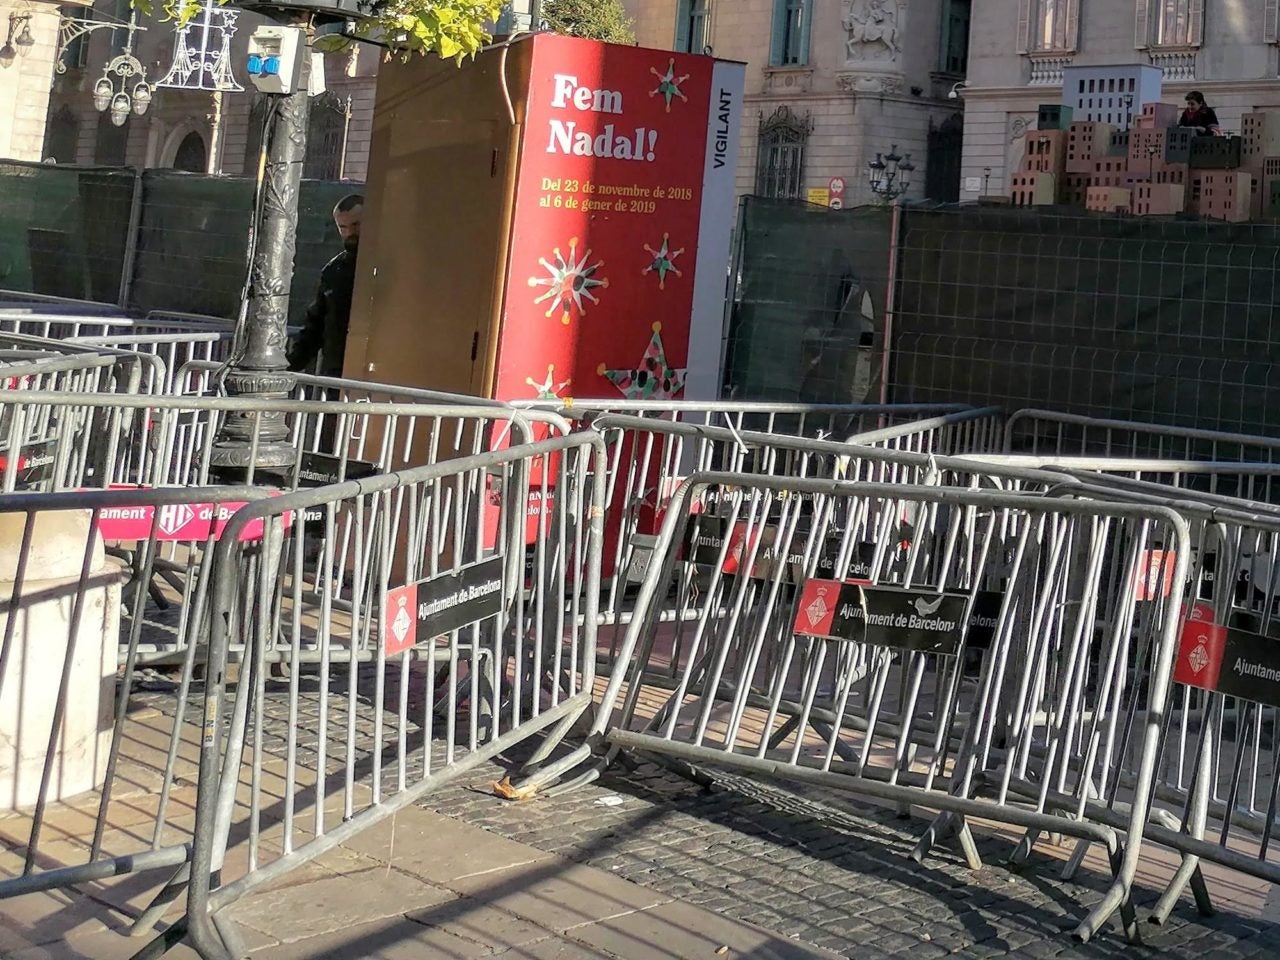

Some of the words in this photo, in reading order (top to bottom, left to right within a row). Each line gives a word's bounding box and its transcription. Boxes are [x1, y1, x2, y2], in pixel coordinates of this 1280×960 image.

[551, 73, 623, 114] Fem
[546, 120, 658, 162] Nadal!
[713, 88, 732, 169] VIGILANT
[539, 194, 551, 208] al
[553, 195, 562, 208] 6
[565, 196, 578, 209] de
[581, 200, 612, 212] gener
[614, 199, 627, 212] de
[630, 200, 656, 214] 2019
[541, 177, 561, 192] Del
[564, 179, 579, 193] 23
[582, 180, 595, 194] de
[598, 182, 650, 197] novembre
[652, 185, 665, 198] de
[667, 187, 693, 201] 2018
[418, 593, 459, 620] Ajuntament
[459, 588, 468, 603] de
[469, 580, 501, 600] Barcelona
[839, 602, 894, 626] Ajuntament
[894, 614, 908, 628] de
